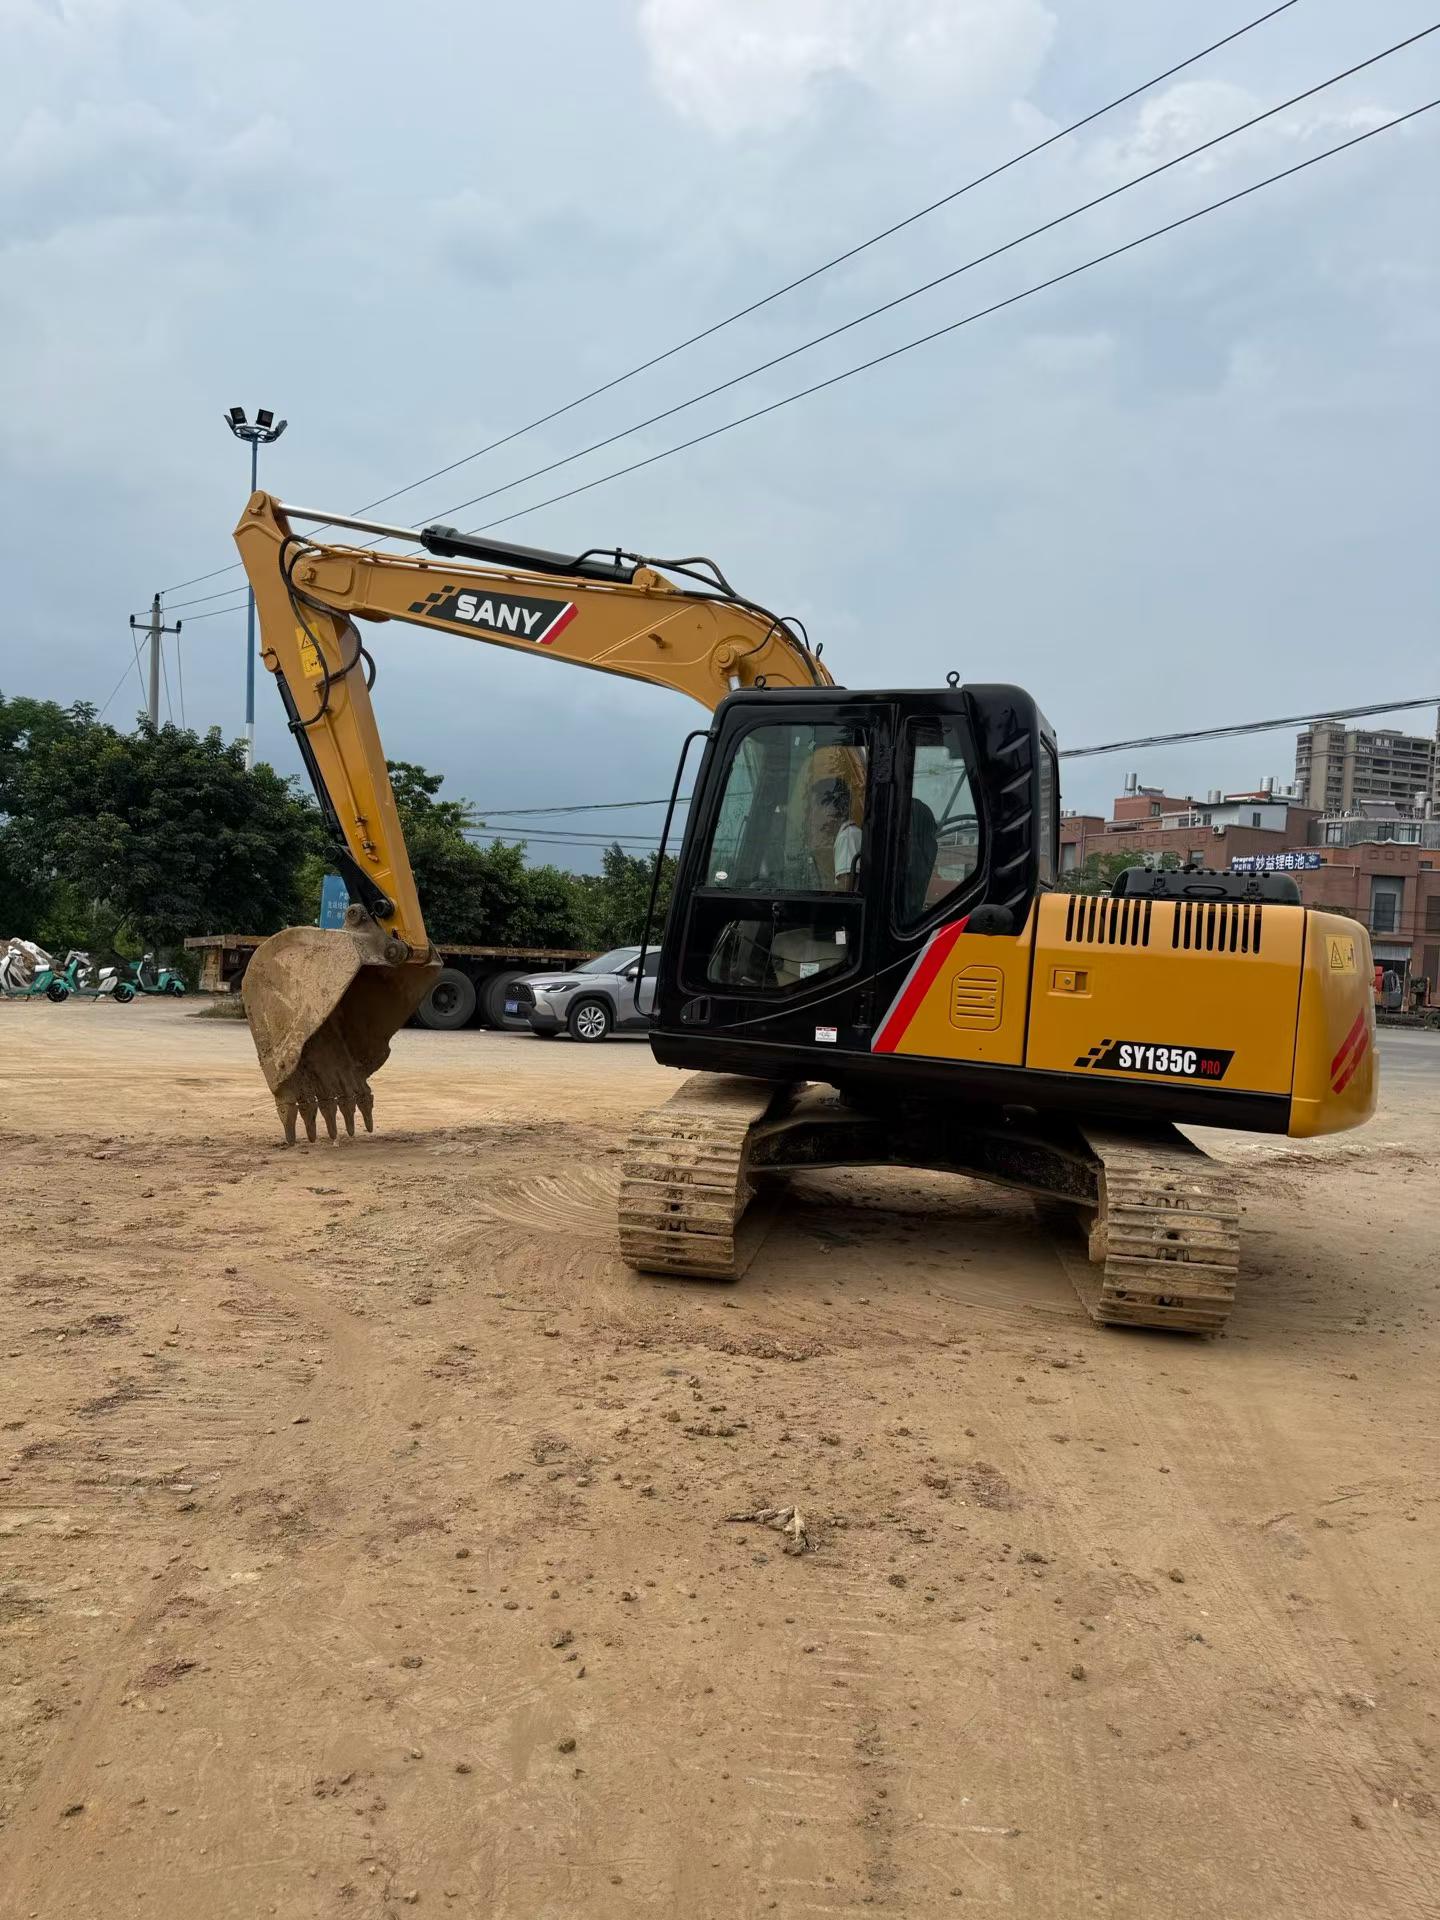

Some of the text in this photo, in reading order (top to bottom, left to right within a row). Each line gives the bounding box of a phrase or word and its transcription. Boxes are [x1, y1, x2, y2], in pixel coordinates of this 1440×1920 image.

[455, 594, 543, 635] SANY
[1255, 853, 1304, 870] 妙益锂电池
[1119, 1044, 1221, 1075] SY135C PRO
